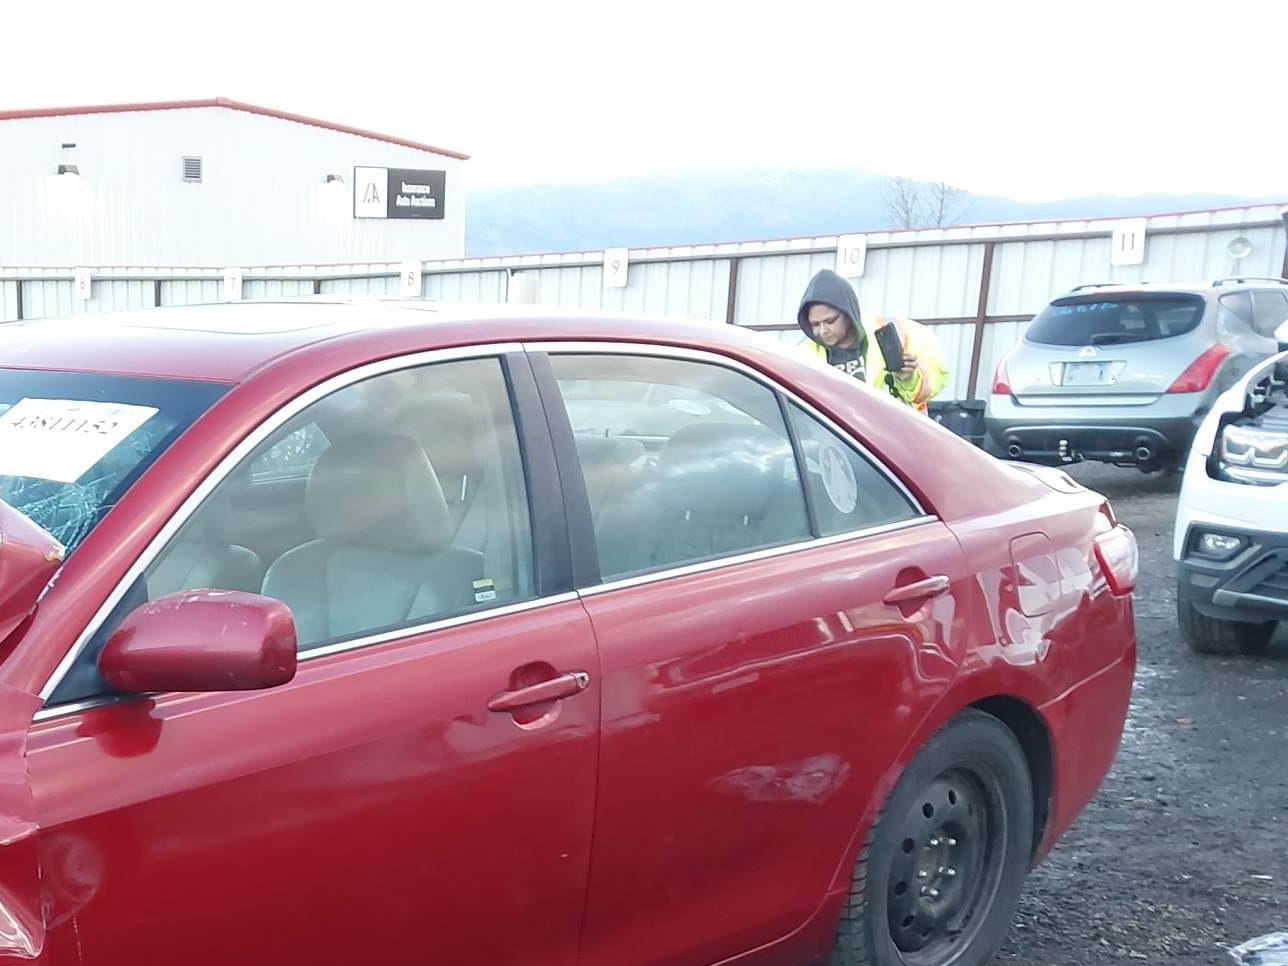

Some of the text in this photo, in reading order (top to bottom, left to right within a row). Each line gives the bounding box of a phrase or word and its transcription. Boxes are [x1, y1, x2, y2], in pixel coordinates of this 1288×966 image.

[1121, 232, 1136, 251] 11
[842, 247, 861, 265] 10
[610, 259, 621, 275] 9
[407, 271, 416, 287] 8
